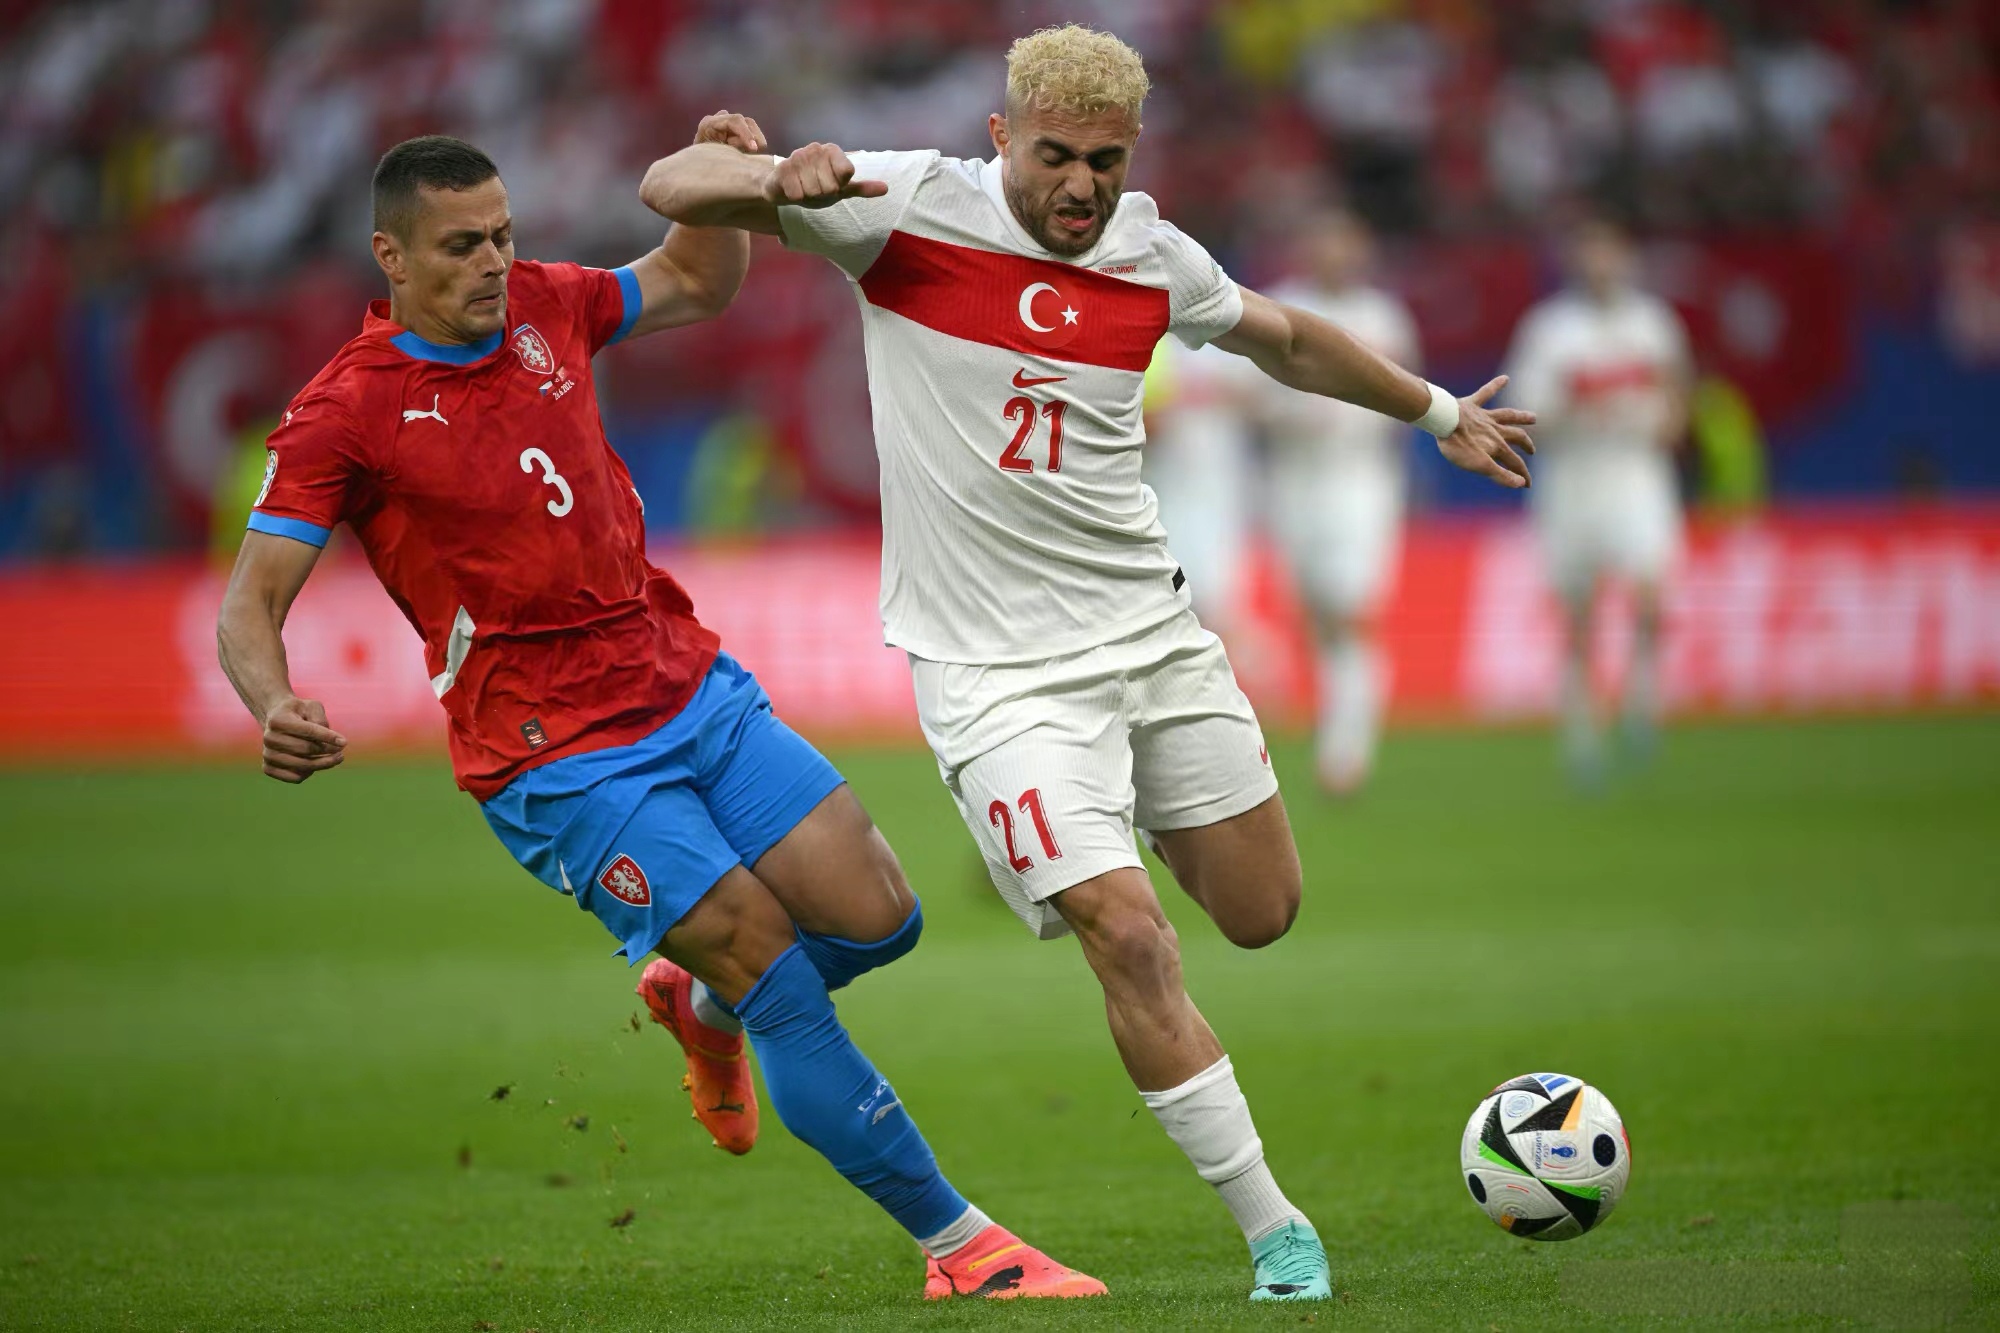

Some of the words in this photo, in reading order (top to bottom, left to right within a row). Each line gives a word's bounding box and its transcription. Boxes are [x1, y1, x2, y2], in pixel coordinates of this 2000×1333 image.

[999, 396, 1069, 473] 21
[519, 447, 574, 517] 3
[988, 787, 1063, 875] 21
